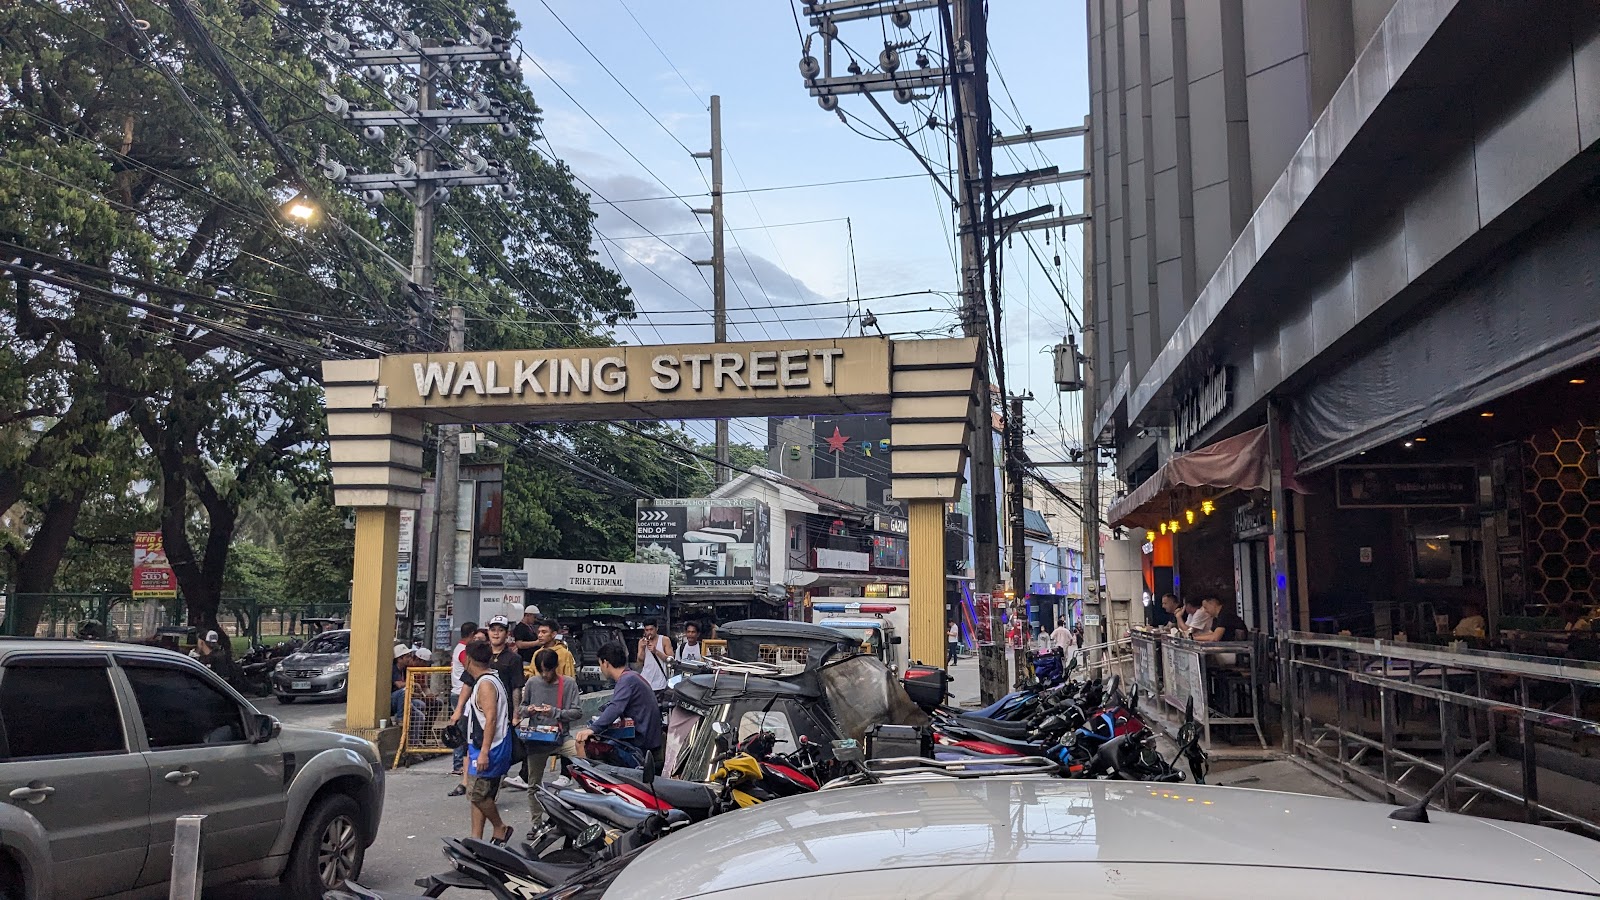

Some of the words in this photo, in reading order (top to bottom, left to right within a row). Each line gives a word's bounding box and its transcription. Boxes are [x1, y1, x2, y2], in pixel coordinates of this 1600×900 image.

[413, 357, 626, 396] WALKING
[650, 348, 844, 390] STREET
[577, 563, 616, 575] BOTDA
[569, 577, 592, 585] TRIKE
[593, 578, 624, 587] TERMINAL
[508, 595, 521, 603] PLDT
